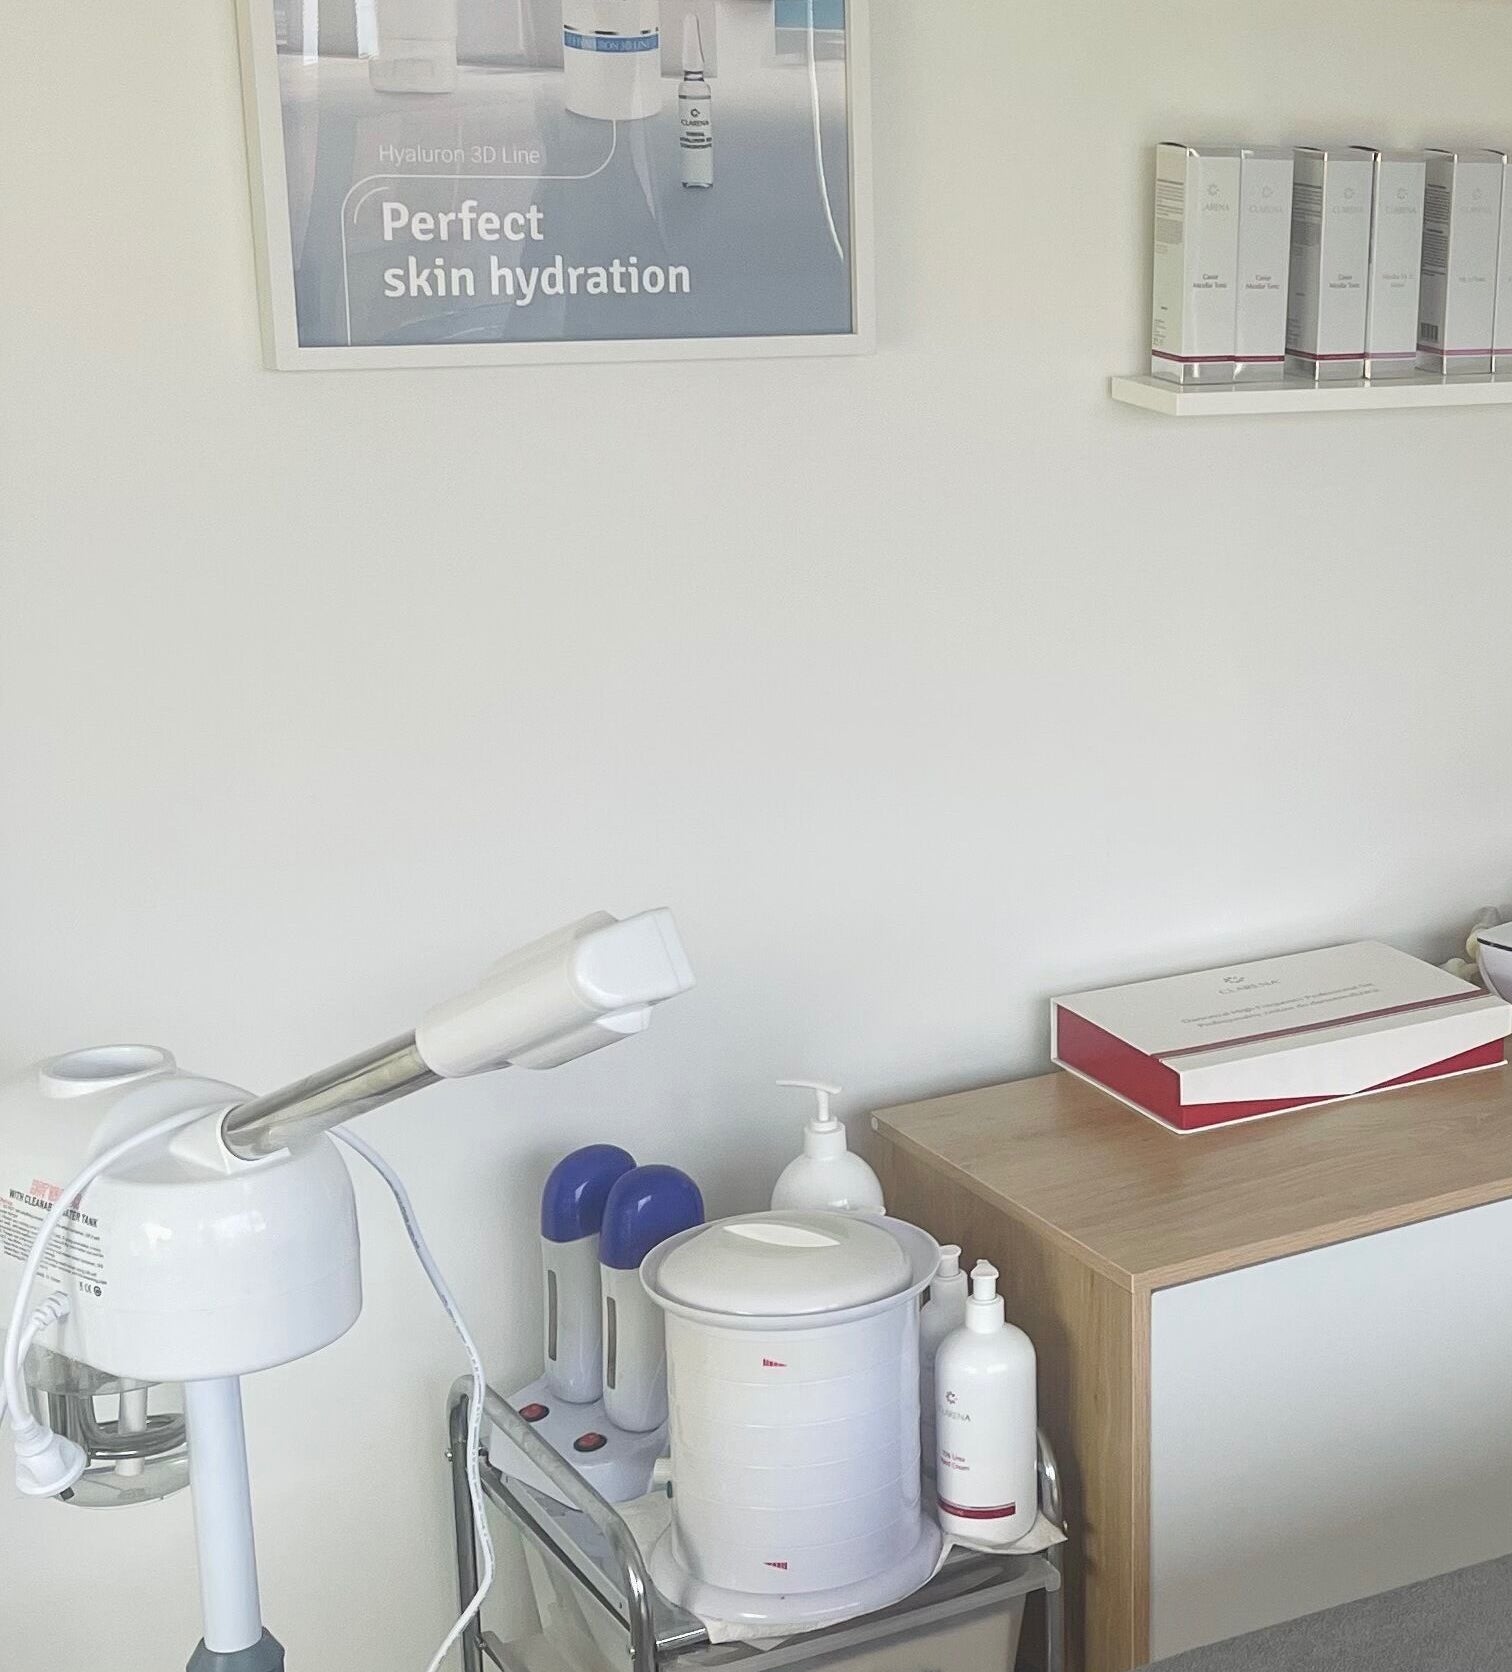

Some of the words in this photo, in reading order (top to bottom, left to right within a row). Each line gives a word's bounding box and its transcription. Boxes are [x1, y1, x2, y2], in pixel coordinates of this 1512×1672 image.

[379, 144, 465, 167] Hyaluron
[471, 145, 497, 163] 3D
[502, 145, 540, 164] Line
[382, 200, 544, 241] Perfect
[384, 256, 475, 298] skin
[491, 255, 690, 307] hydration
[9, 1188, 24, 1202] WITH
[82, 1212, 98, 1229] TANK
